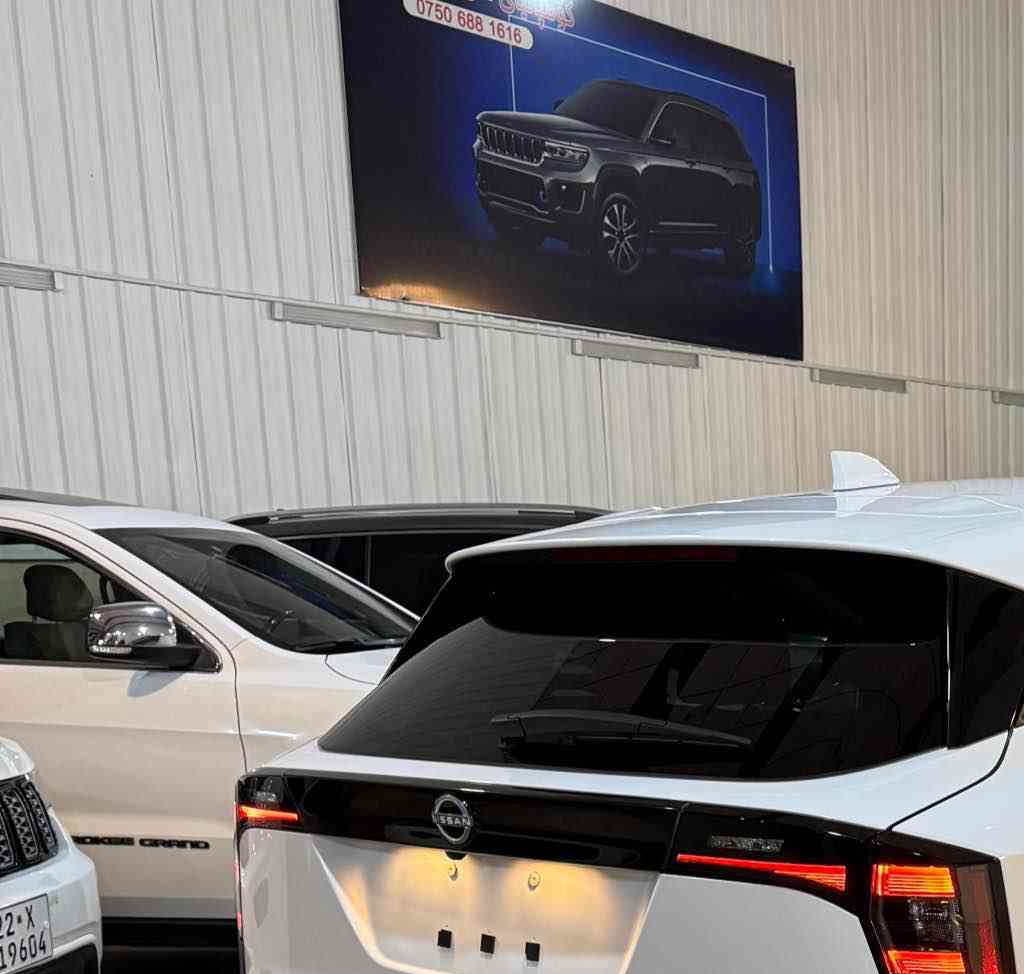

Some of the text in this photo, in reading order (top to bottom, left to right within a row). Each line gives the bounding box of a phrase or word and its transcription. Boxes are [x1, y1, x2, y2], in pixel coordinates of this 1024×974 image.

[416, 0, 452, 23] 0750
[457, 10, 484, 33] 688
[489, 20, 522, 44] 1616
